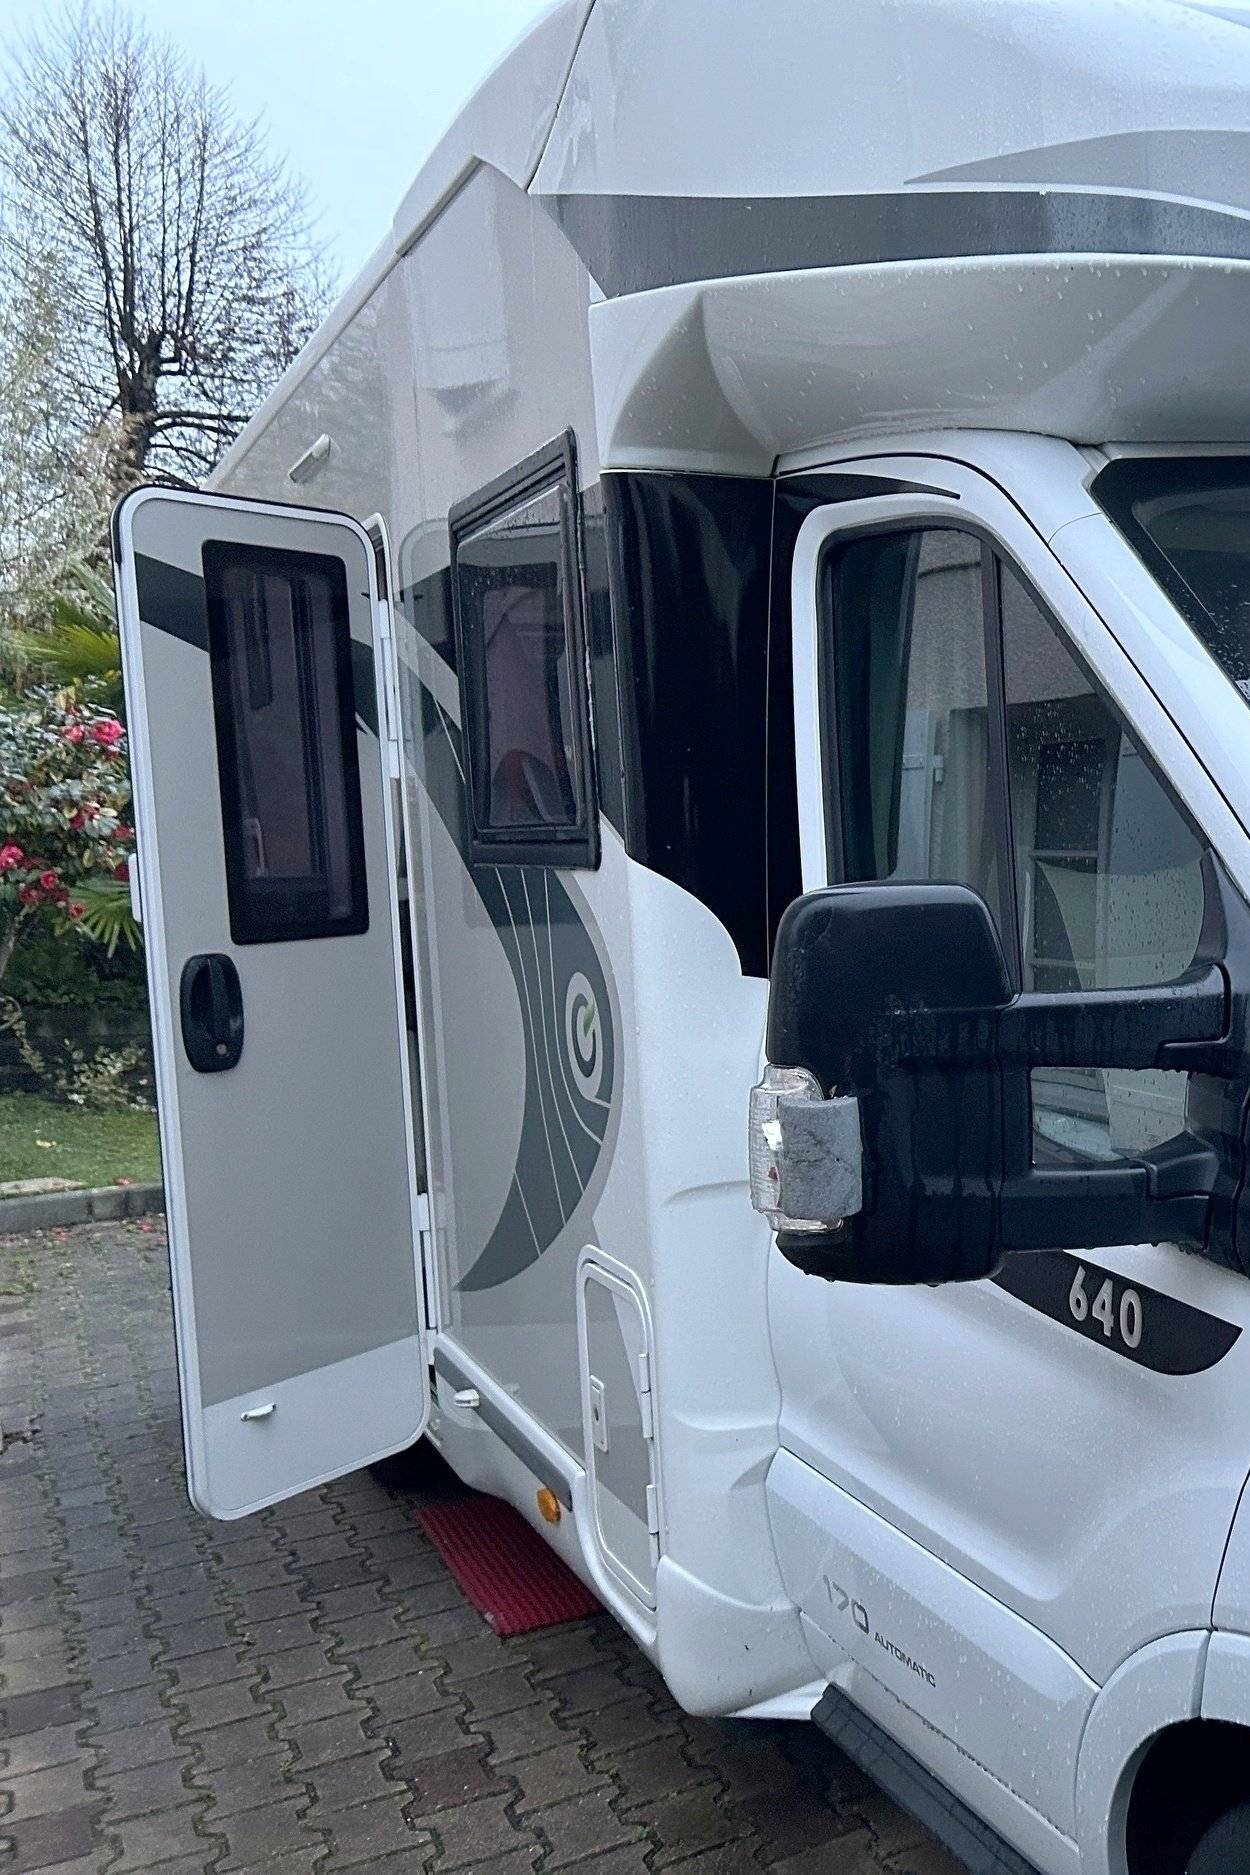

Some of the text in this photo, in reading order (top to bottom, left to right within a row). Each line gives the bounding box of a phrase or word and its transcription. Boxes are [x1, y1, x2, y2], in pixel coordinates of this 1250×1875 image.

[1068, 1265, 1143, 1348] 640
[822, 1574, 937, 1689] 170 AUTOMATIC
